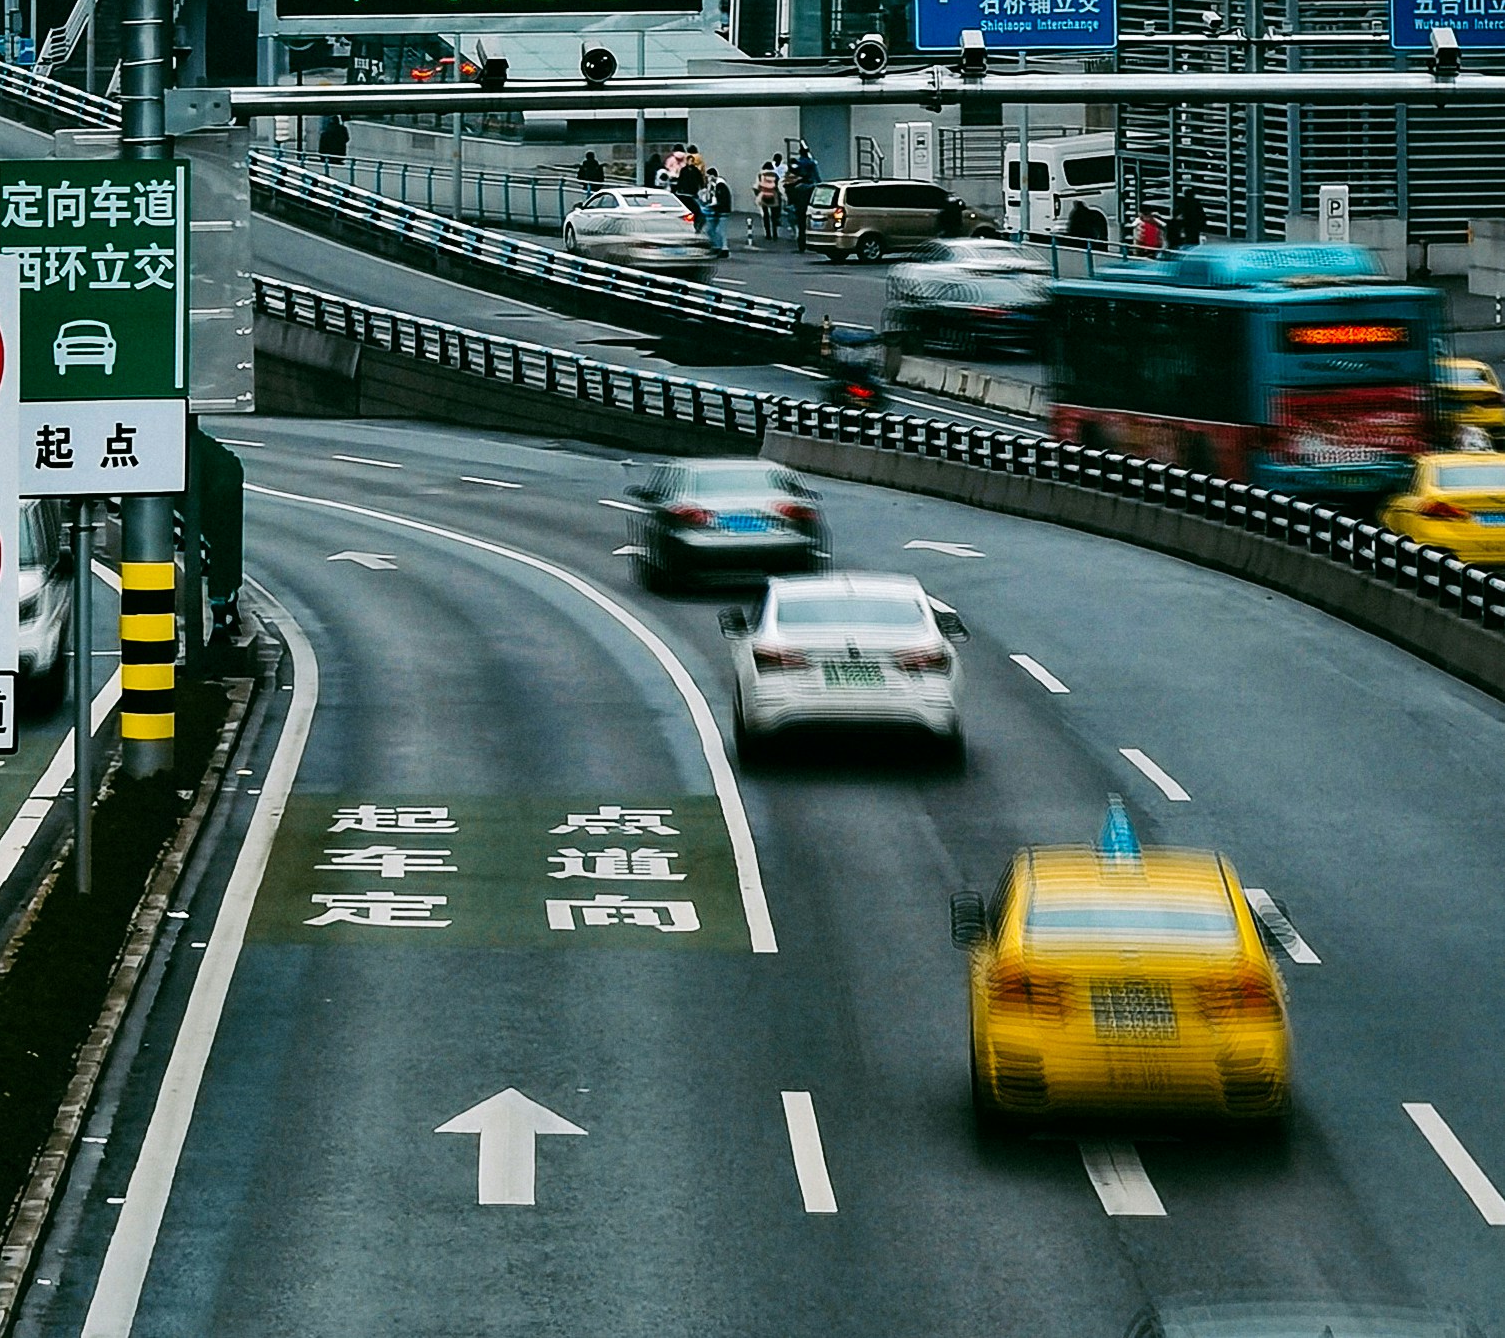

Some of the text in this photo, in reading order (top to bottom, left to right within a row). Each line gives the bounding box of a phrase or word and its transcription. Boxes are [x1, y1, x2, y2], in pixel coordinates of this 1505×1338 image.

[980, 18, 1100, 34] Shiqiaopu Interchange
[0, 179, 176, 231] 定向车道
[1330, 200, 1341, 215] P
[1, 244, 176, 292] 西环立交
[35, 421, 140, 470] 起点
